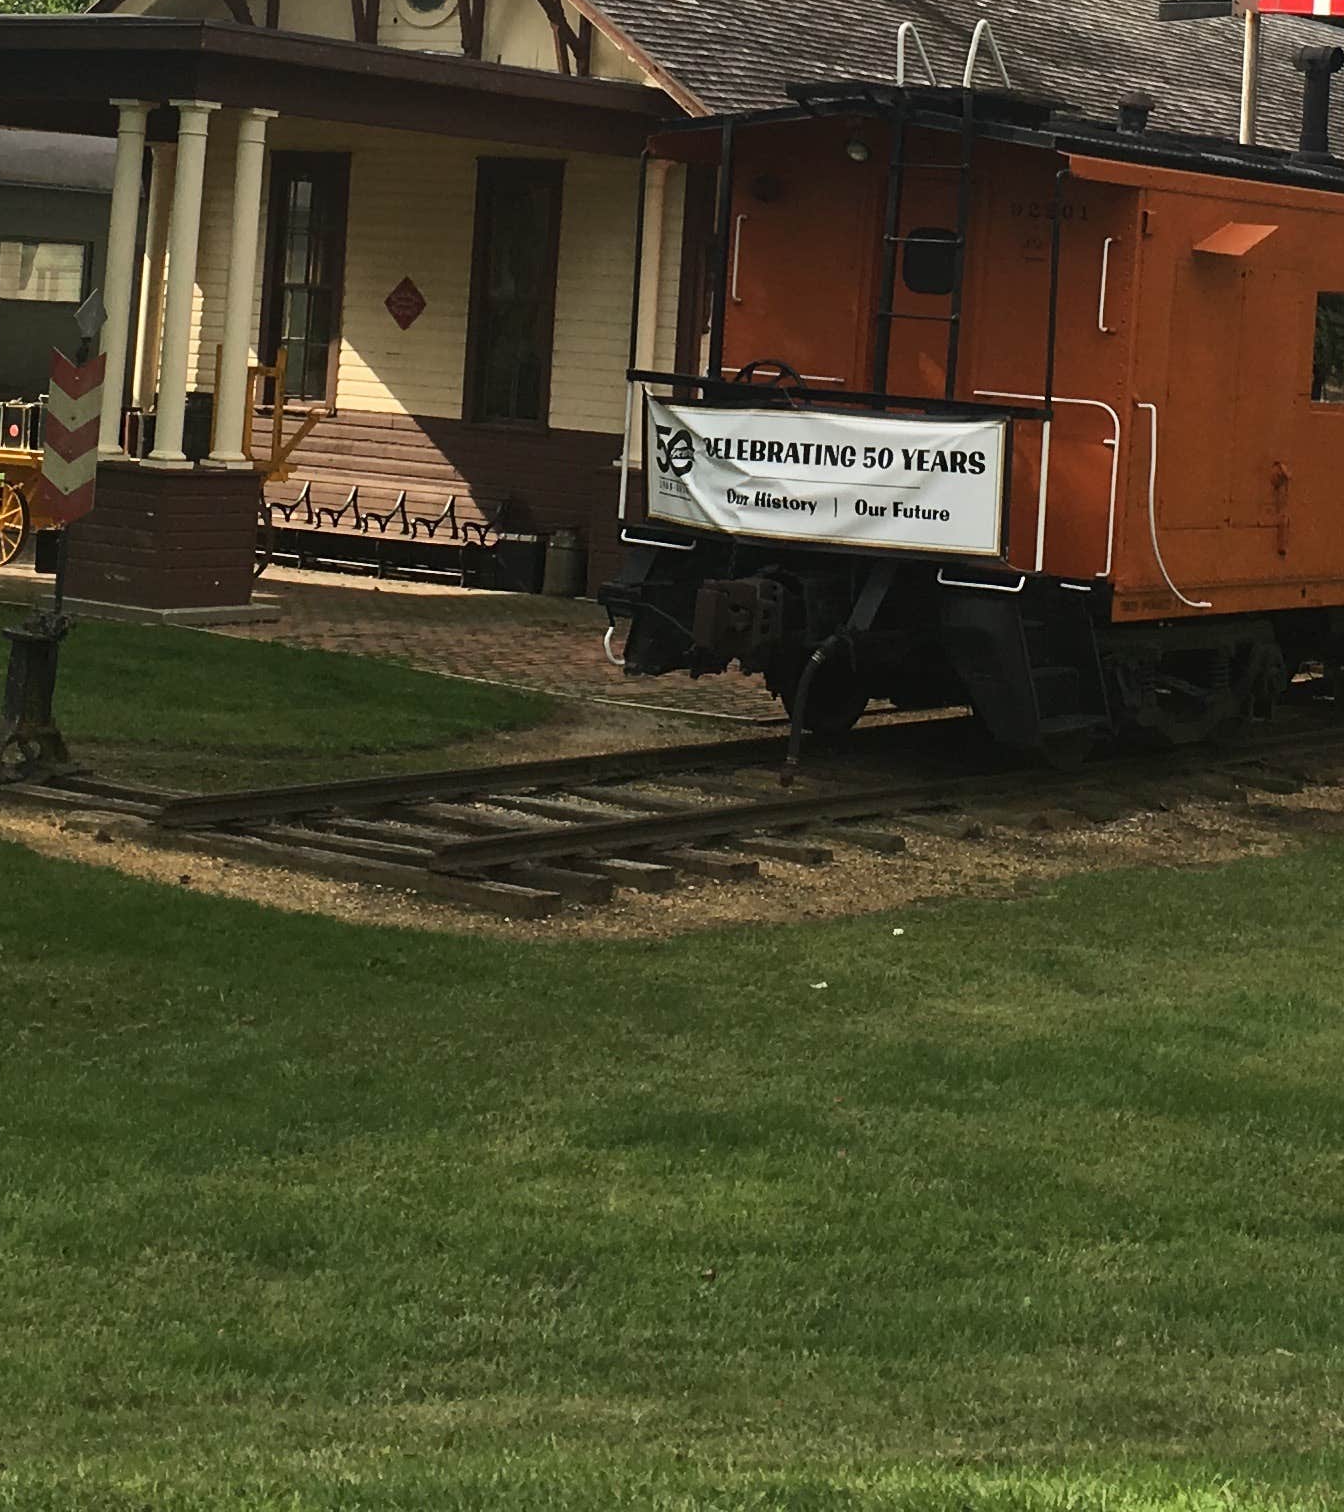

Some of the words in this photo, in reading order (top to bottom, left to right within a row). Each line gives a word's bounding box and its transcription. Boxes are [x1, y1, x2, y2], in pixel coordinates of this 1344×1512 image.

[862, 446, 894, 469] 50
[901, 448, 986, 475] YEARS
[726, 488, 750, 506] Our
[755, 491, 818, 515] History
[854, 498, 887, 517] Our
[892, 501, 950, 522] Future
